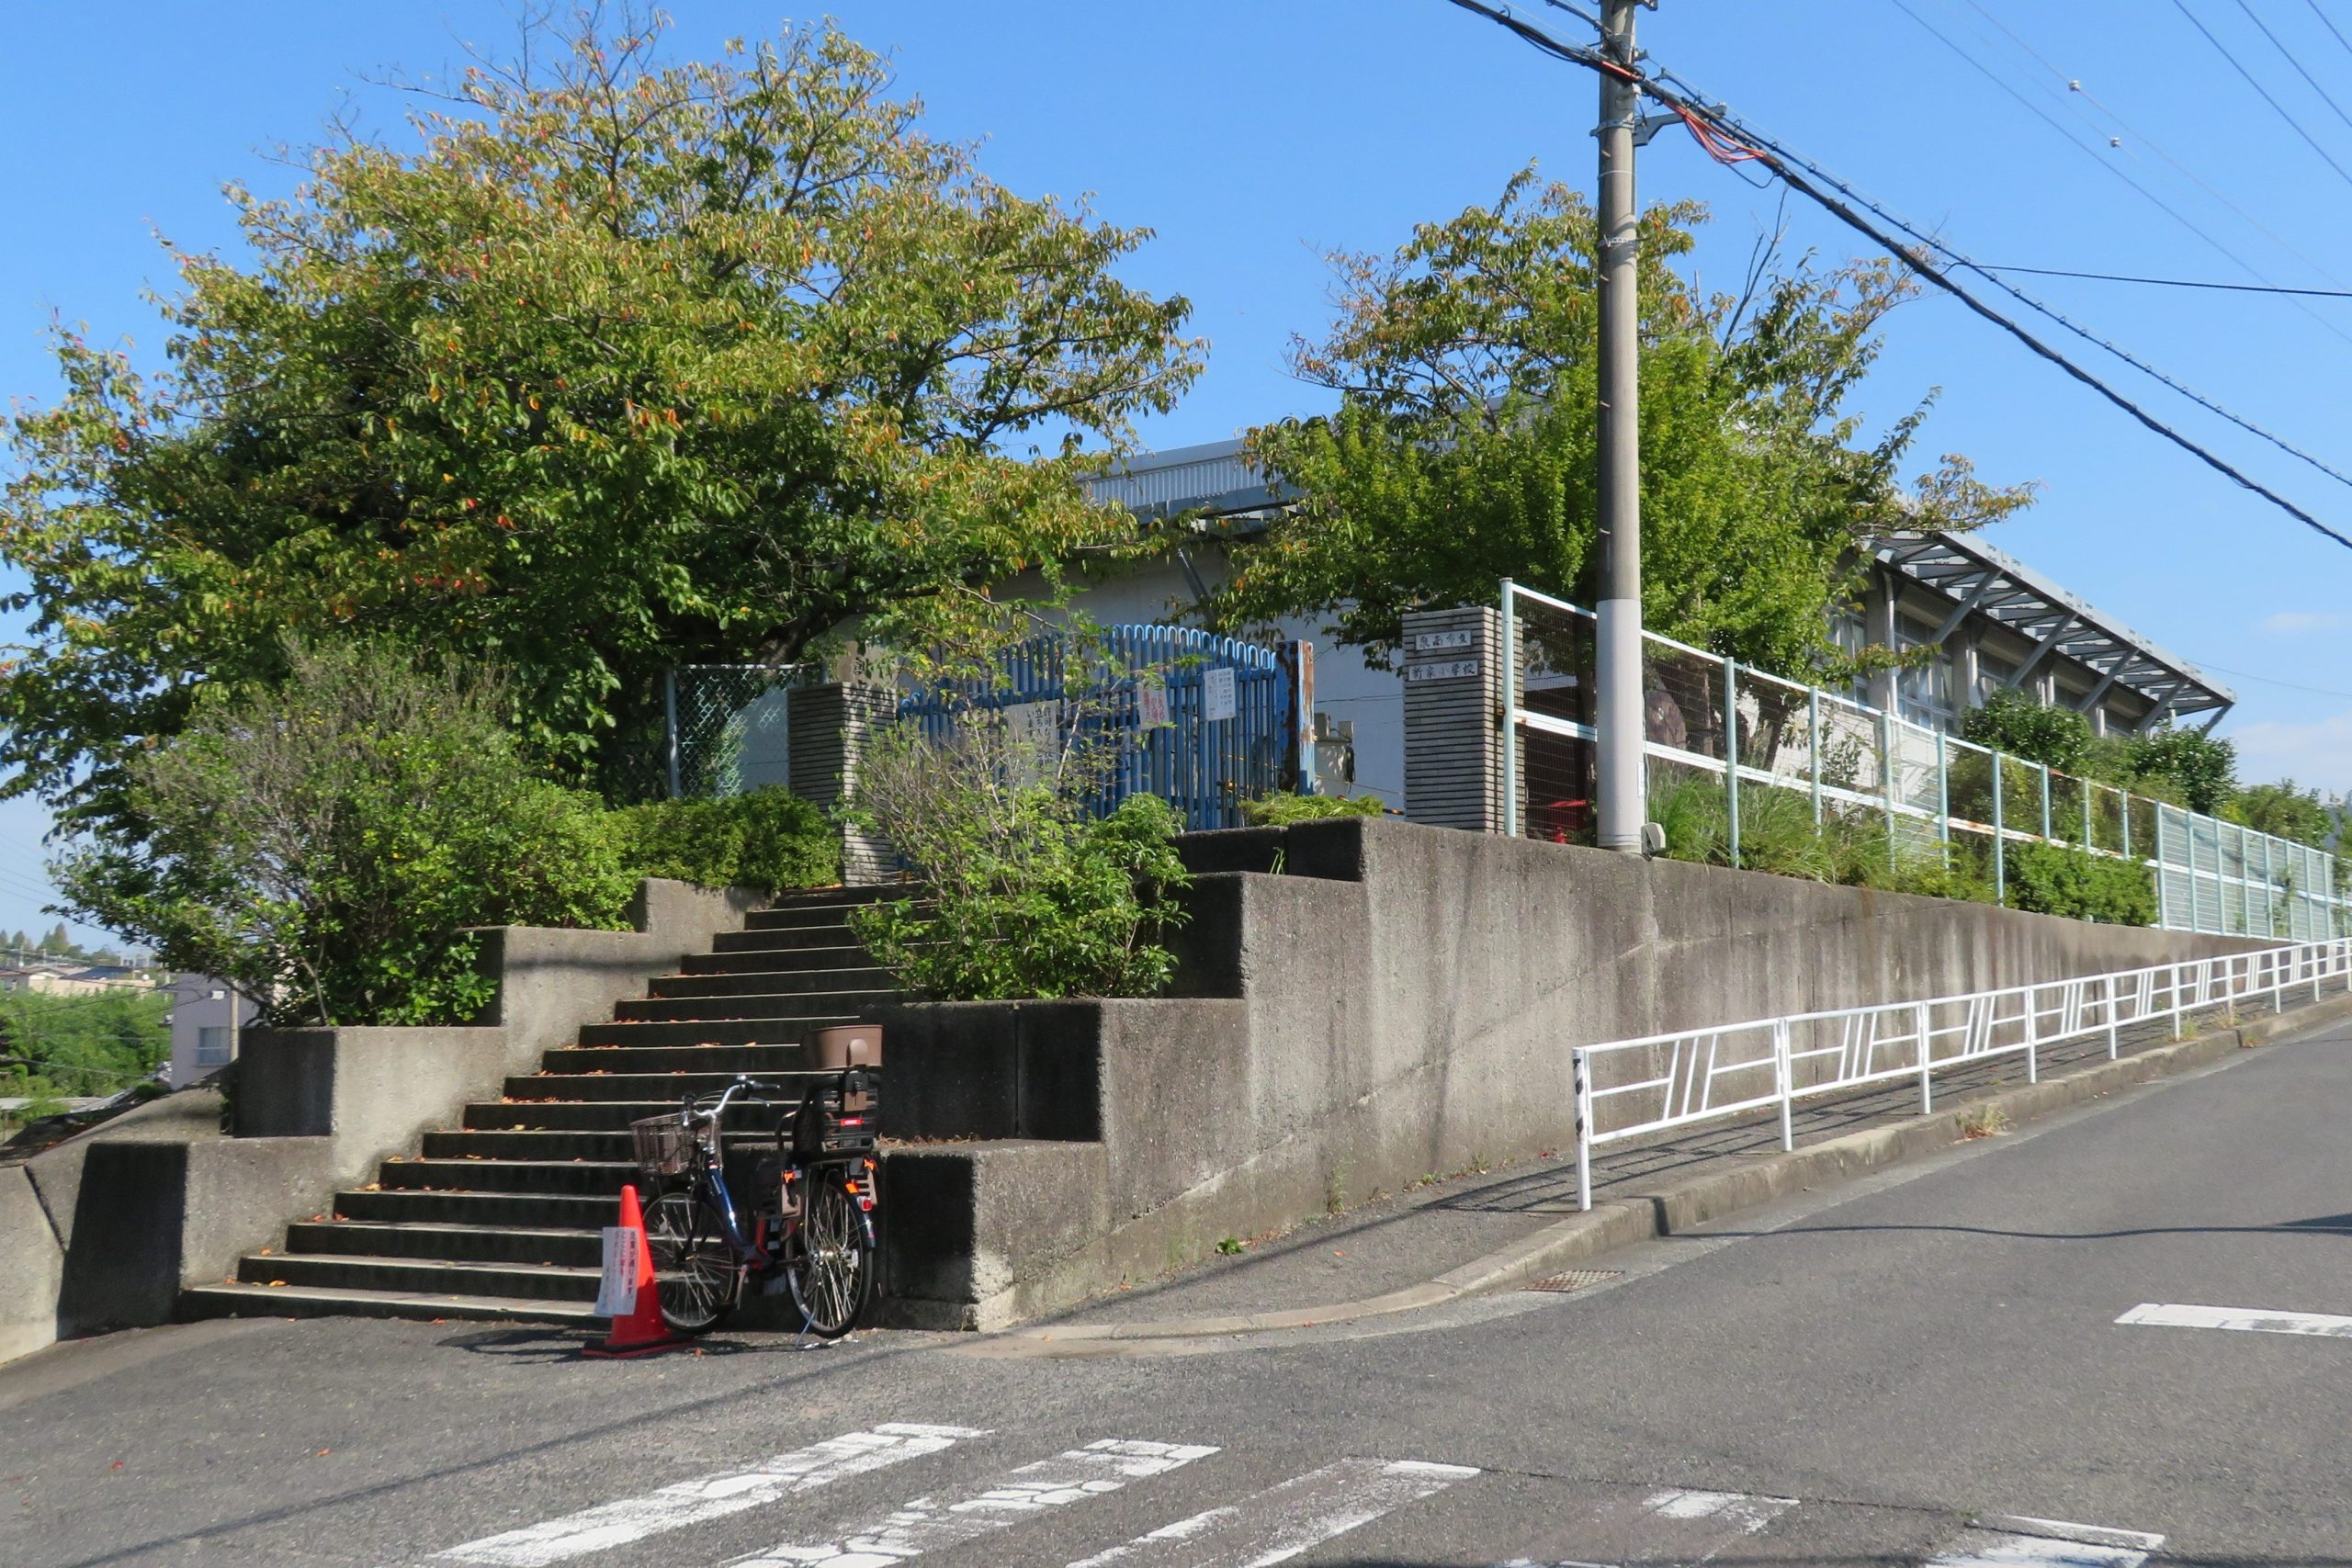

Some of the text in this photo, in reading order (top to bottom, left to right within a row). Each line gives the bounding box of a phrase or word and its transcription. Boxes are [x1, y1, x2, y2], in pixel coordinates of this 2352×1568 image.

[1419, 633, 1467, 649] 泉南市立
[1412, 662, 1475, 680] 新家小学校
